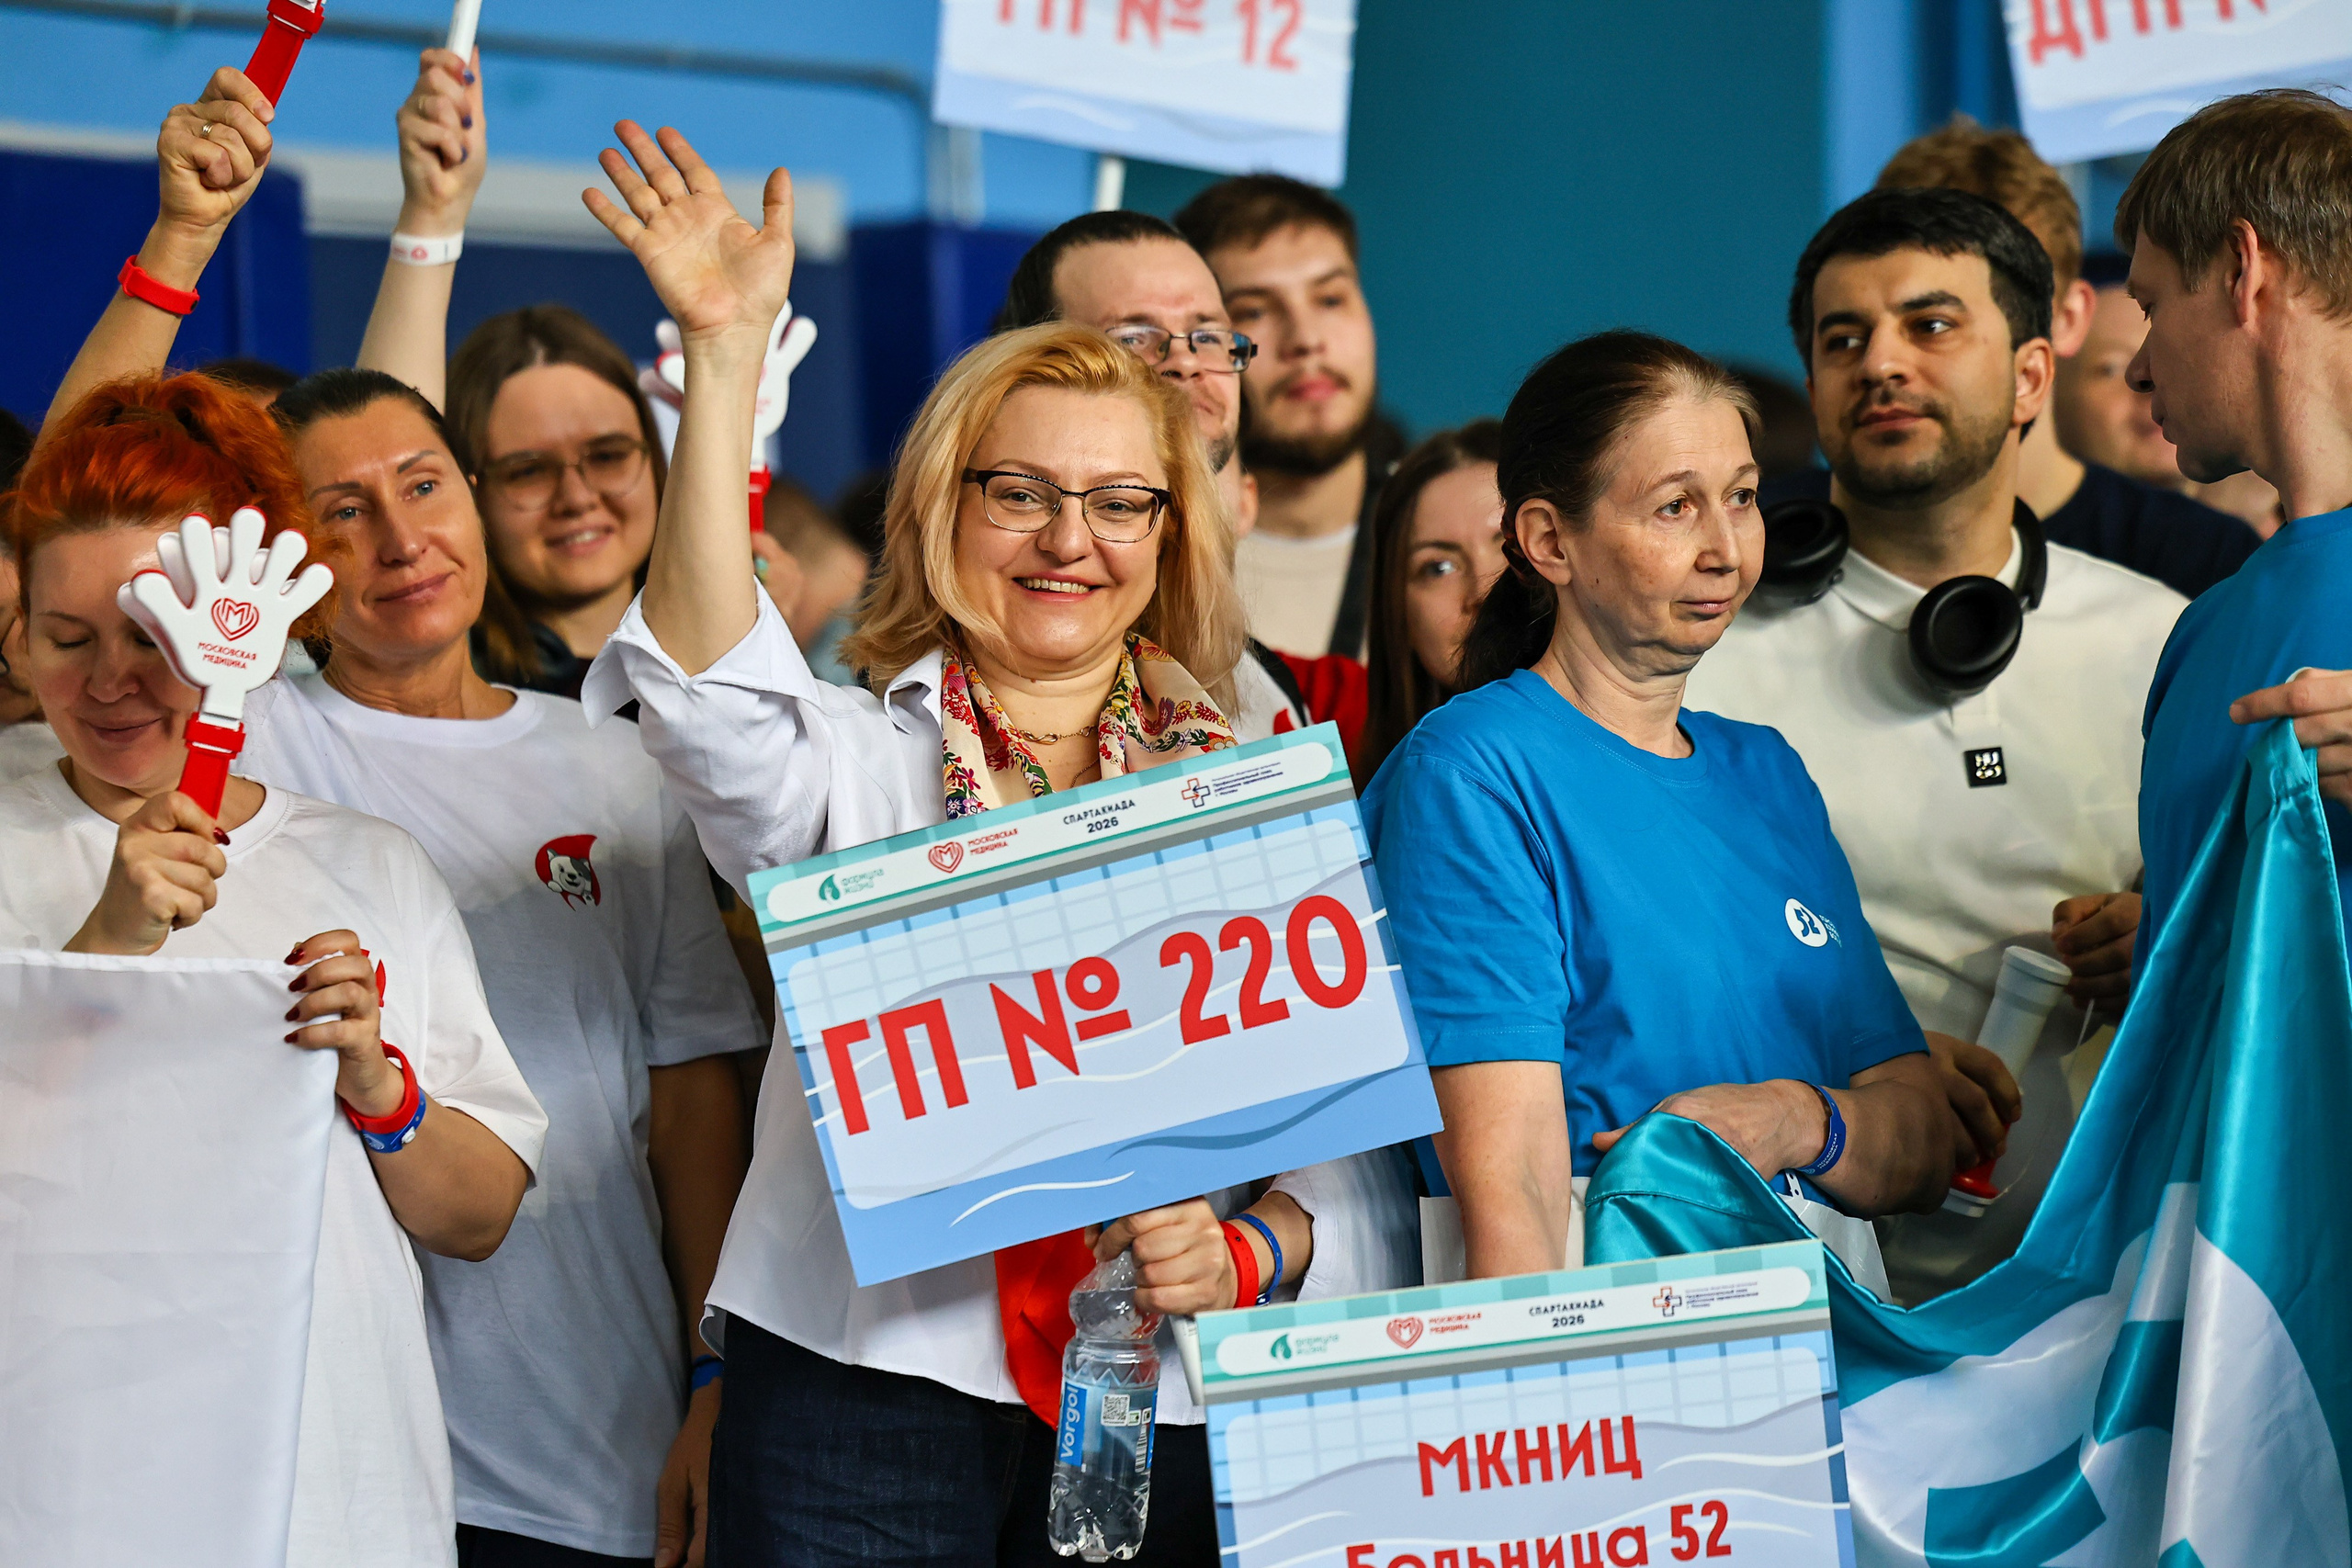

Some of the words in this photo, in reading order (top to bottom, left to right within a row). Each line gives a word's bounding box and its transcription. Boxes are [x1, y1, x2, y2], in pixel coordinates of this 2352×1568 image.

[1237, 0, 1302, 72] 12
[198, 642, 256, 660] МОСКОВСКАЯ
[202, 653, 247, 670] МЕДИЦИНА
[1063, 799, 1136, 826] СПАРТАКИАДА
[1087, 817, 1119, 834] 2026
[967, 829, 1018, 848] МОСКОВСКАЯ
[970, 840, 1008, 855] МЕДИЦИНА
[1793, 907, 1821, 937] 52
[820, 998, 969, 1136] ГП
[989, 955, 1132, 1090] №
[1159, 895, 1367, 1045] 220
[1529, 1299, 1605, 1315] СПАРТАКИАДА
[1552, 1314, 1585, 1328] 2026
[1418, 1415, 1643, 1498] МКНИЦ
[1669, 1499, 1733, 1562] 52
